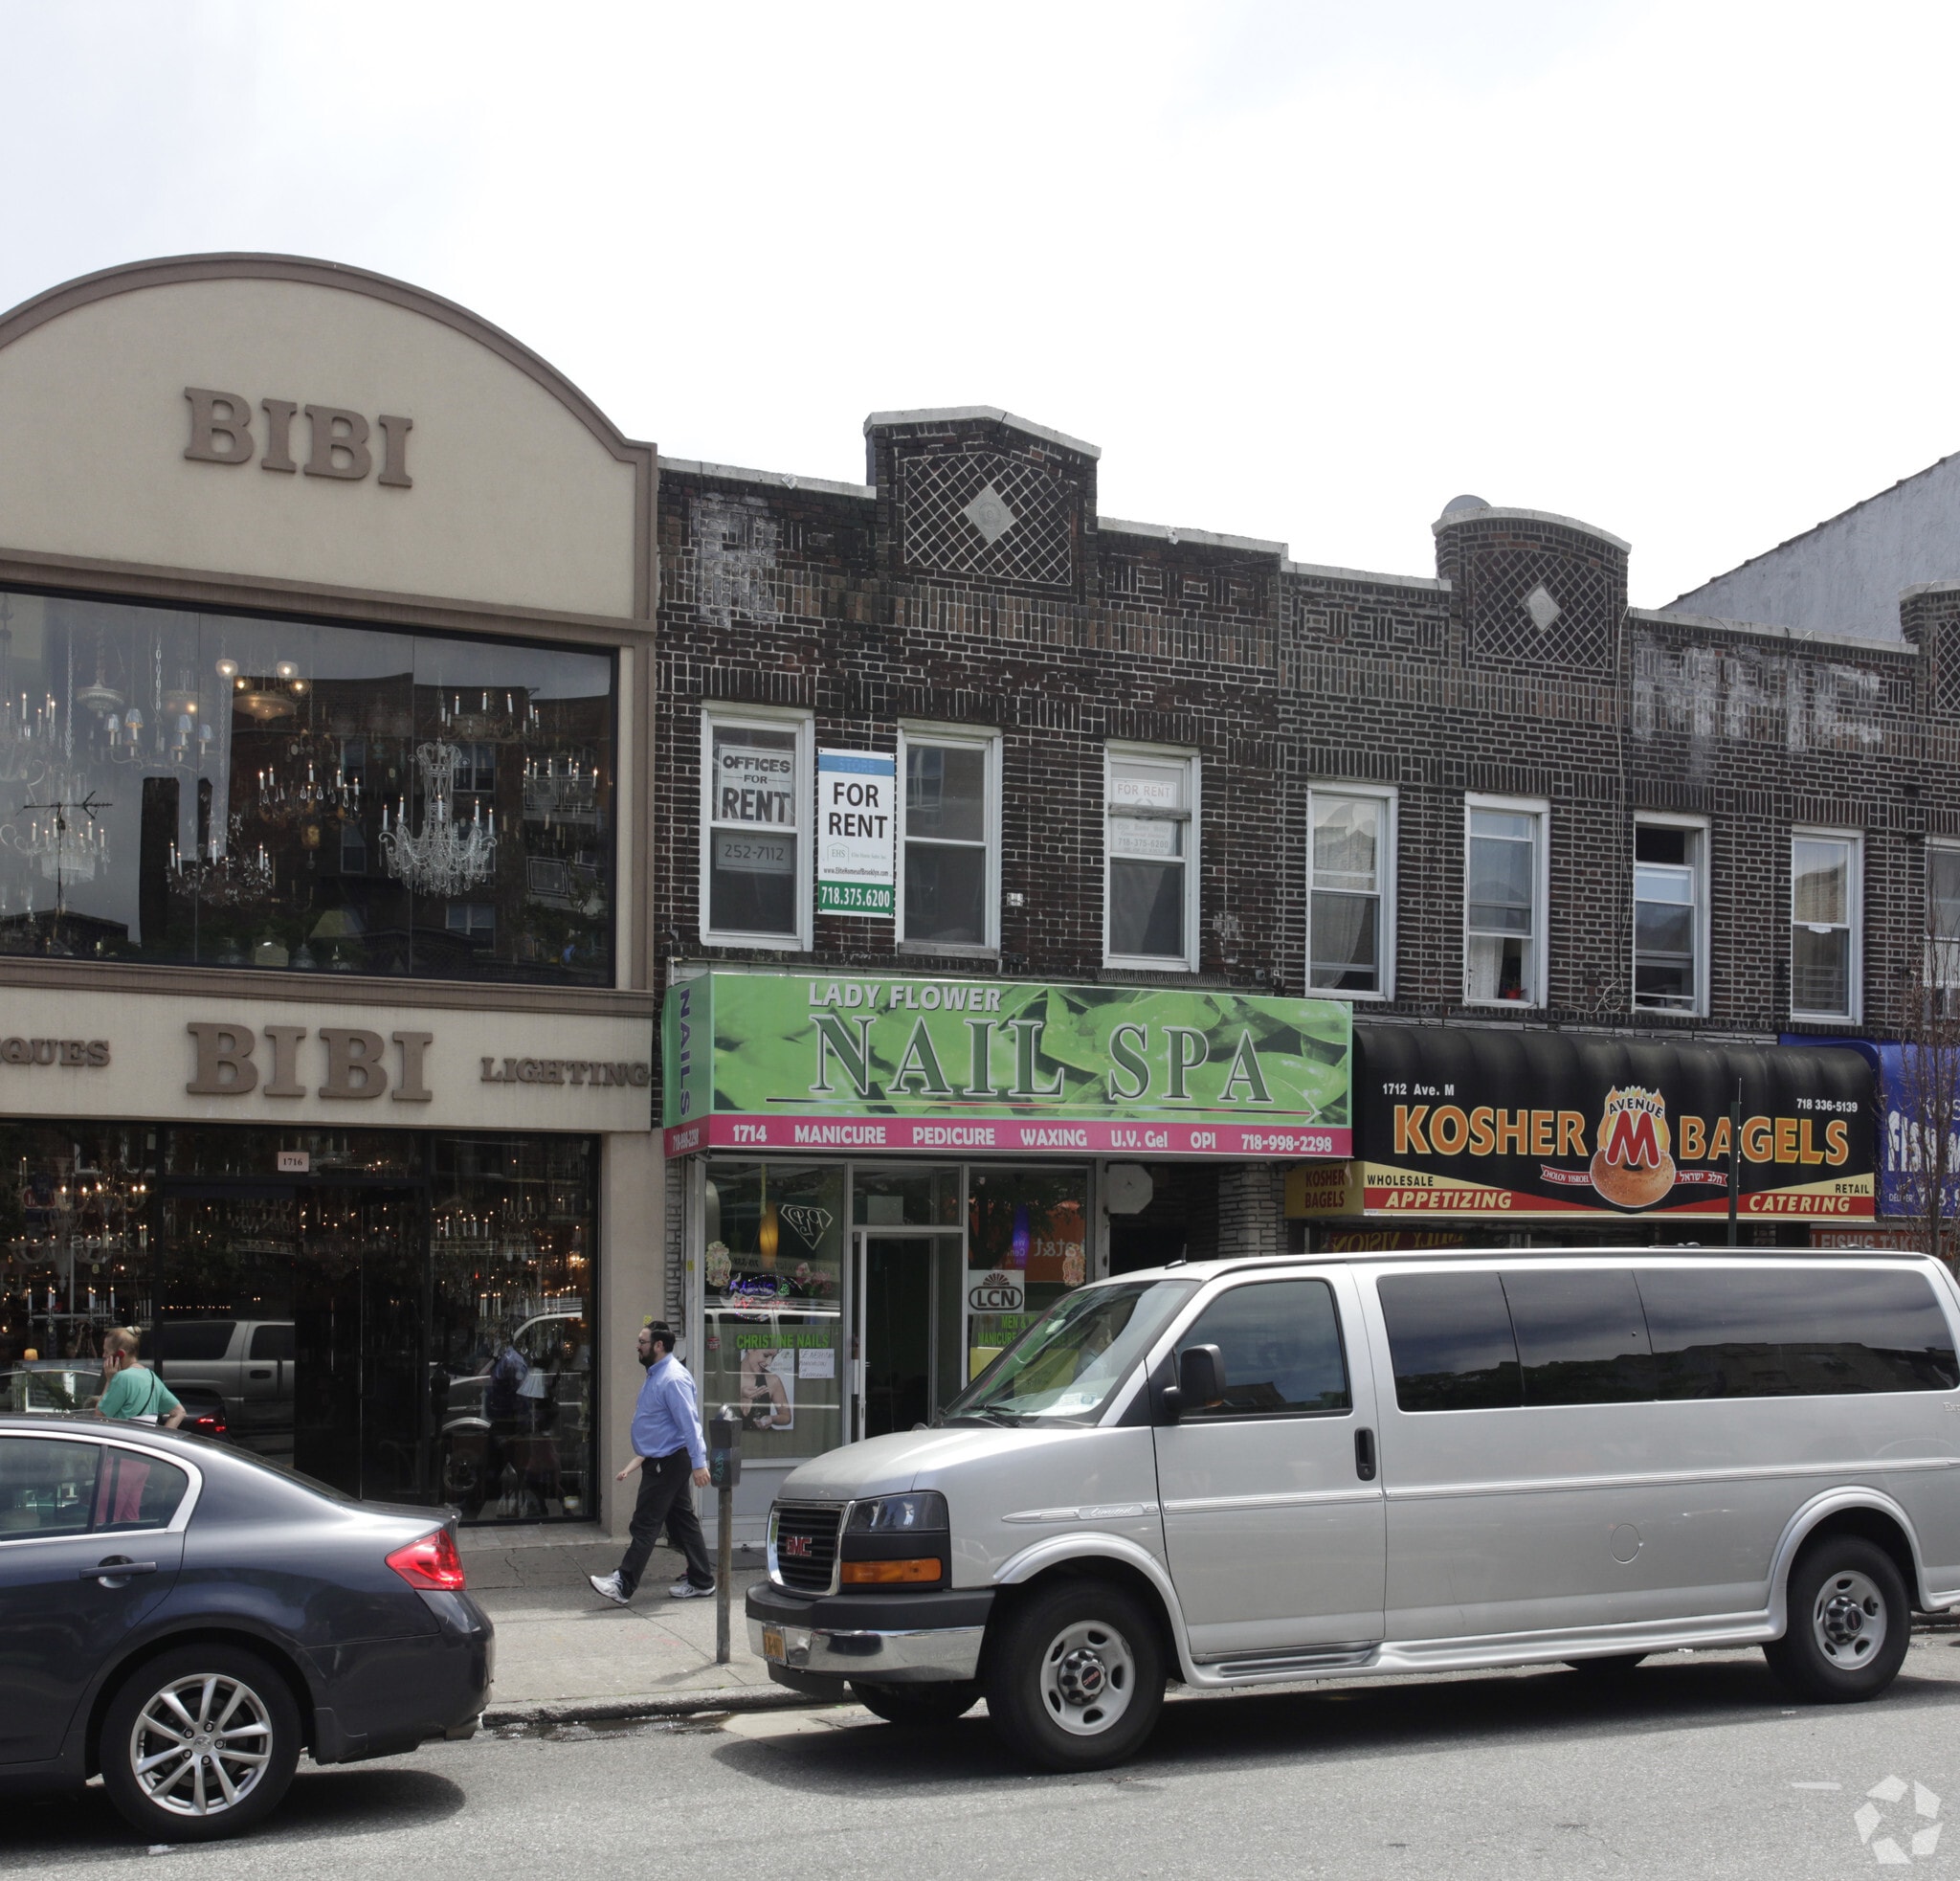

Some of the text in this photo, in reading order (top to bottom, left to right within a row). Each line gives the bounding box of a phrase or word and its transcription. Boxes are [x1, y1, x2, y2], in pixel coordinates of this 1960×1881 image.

[184, 386, 413, 489] BIBI
[723, 755, 791, 773] OFFICES
[744, 774, 768, 784] FOR
[833, 782, 880, 808] FOR
[1118, 784, 1170, 797] FOR RENT
[722, 787, 791, 822] RENT
[829, 813, 888, 839] RENT
[724, 844, 785, 861] 252-7112
[821, 886, 891, 907] 718.375.6200
[809, 982, 1001, 1012] LADY FLOWER
[0, 1037, 111, 1066] QUES
[187, 1021, 434, 1102] BIBI
[679, 988, 691, 1117] NAILS
[809, 1014, 1274, 1102] NAIL SPA
[481, 1057, 651, 1087] LIGHTING
[1383, 1083, 1455, 1096] 1712 Ave. M
[1608, 1097, 1663, 1119] AVENUE
[1796, 1098, 1813, 1110] 718
[733, 1125, 1332, 1153] 1714 MANICURE PEDICURE WAXING U.V. Gel OPI 718-998-2298
[1393, 1105, 1849, 1169] KOSHER M BAGELS
[282, 1157, 303, 1167] 1716
[1305, 1167, 1345, 1188] KOSHER
[1367, 1174, 1434, 1187] WHOLESALE
[1835, 1183, 1870, 1195] RETAIL
[1304, 1191, 1345, 1209] BAGELS
[1385, 1191, 1512, 1209] APPETIZING
[1748, 1195, 1850, 1212] CATERING
[977, 1290, 1014, 1307] LCN
[1001, 1315, 1018, 1329] MEN
[736, 1334, 793, 1349] CHRISTINE
[797, 1333, 829, 1348] NAILS
[787, 1535, 813, 1556] GMC
